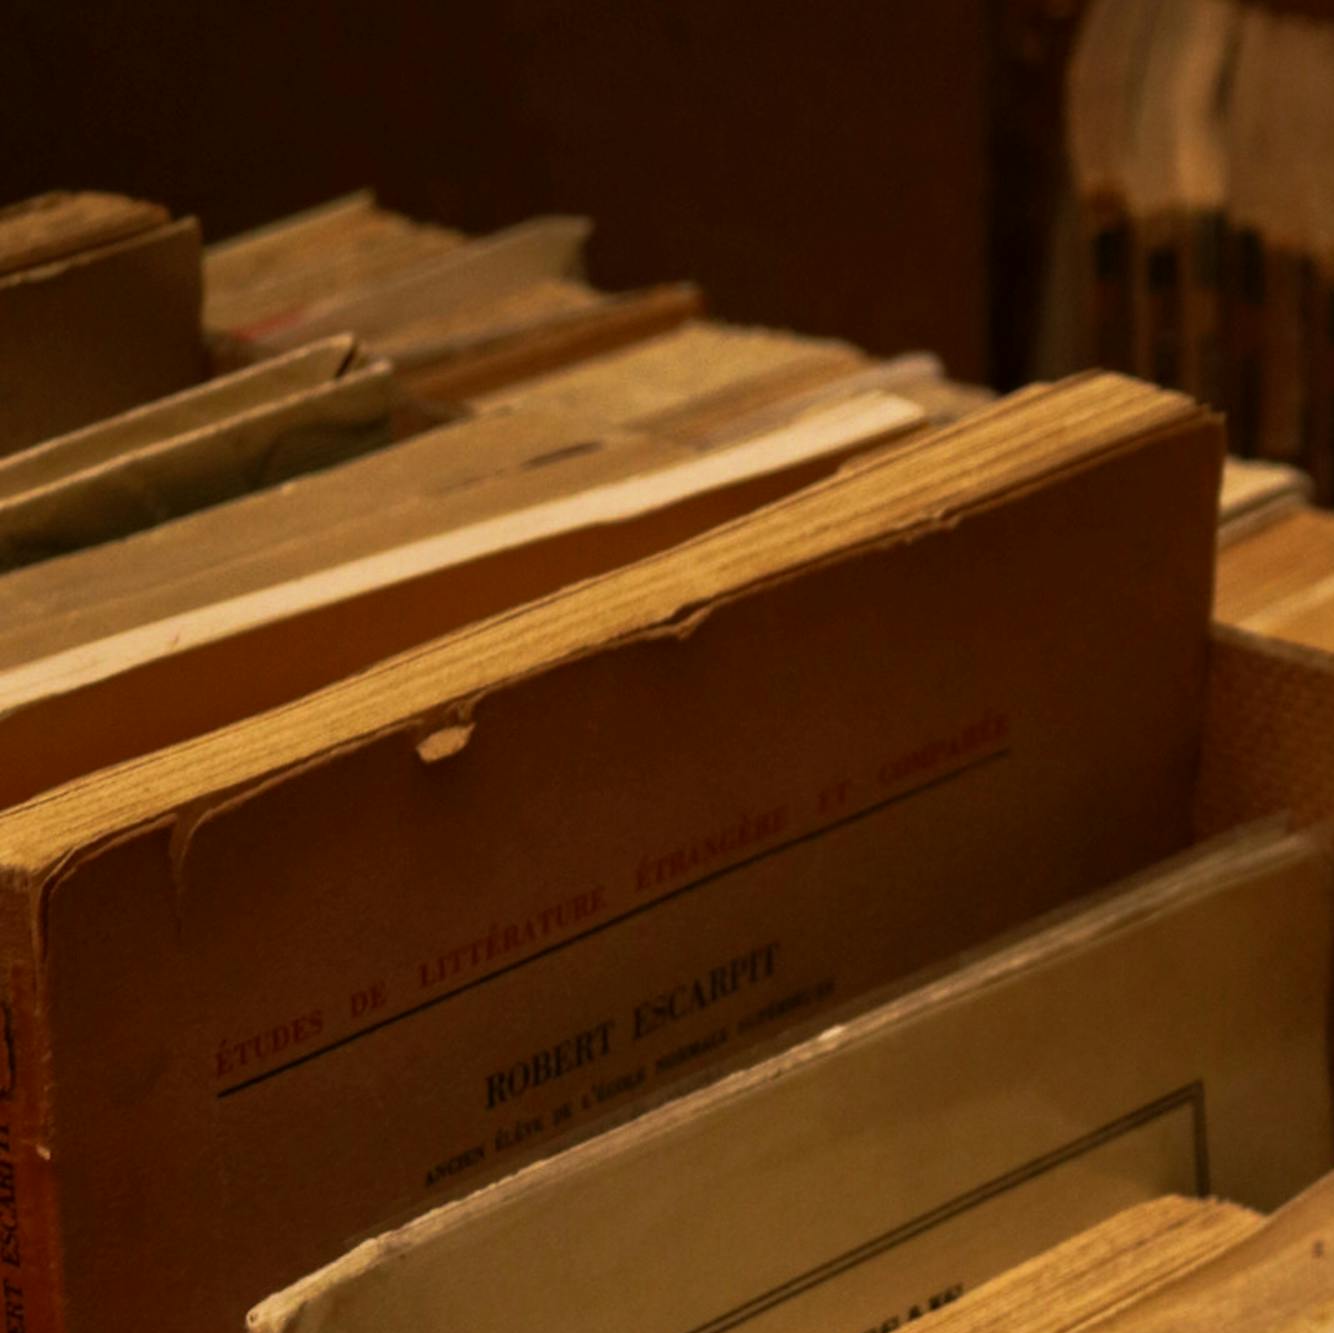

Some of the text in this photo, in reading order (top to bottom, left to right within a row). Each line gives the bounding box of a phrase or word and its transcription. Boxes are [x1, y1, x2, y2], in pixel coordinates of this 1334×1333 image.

[213, 1008, 325, 1078] ÉTUDES
[349, 982, 388, 1018] DE
[417, 885, 607, 990] LITTÉRATURE
[486, 942, 782, 1110] ROBERT ESCARPIT
